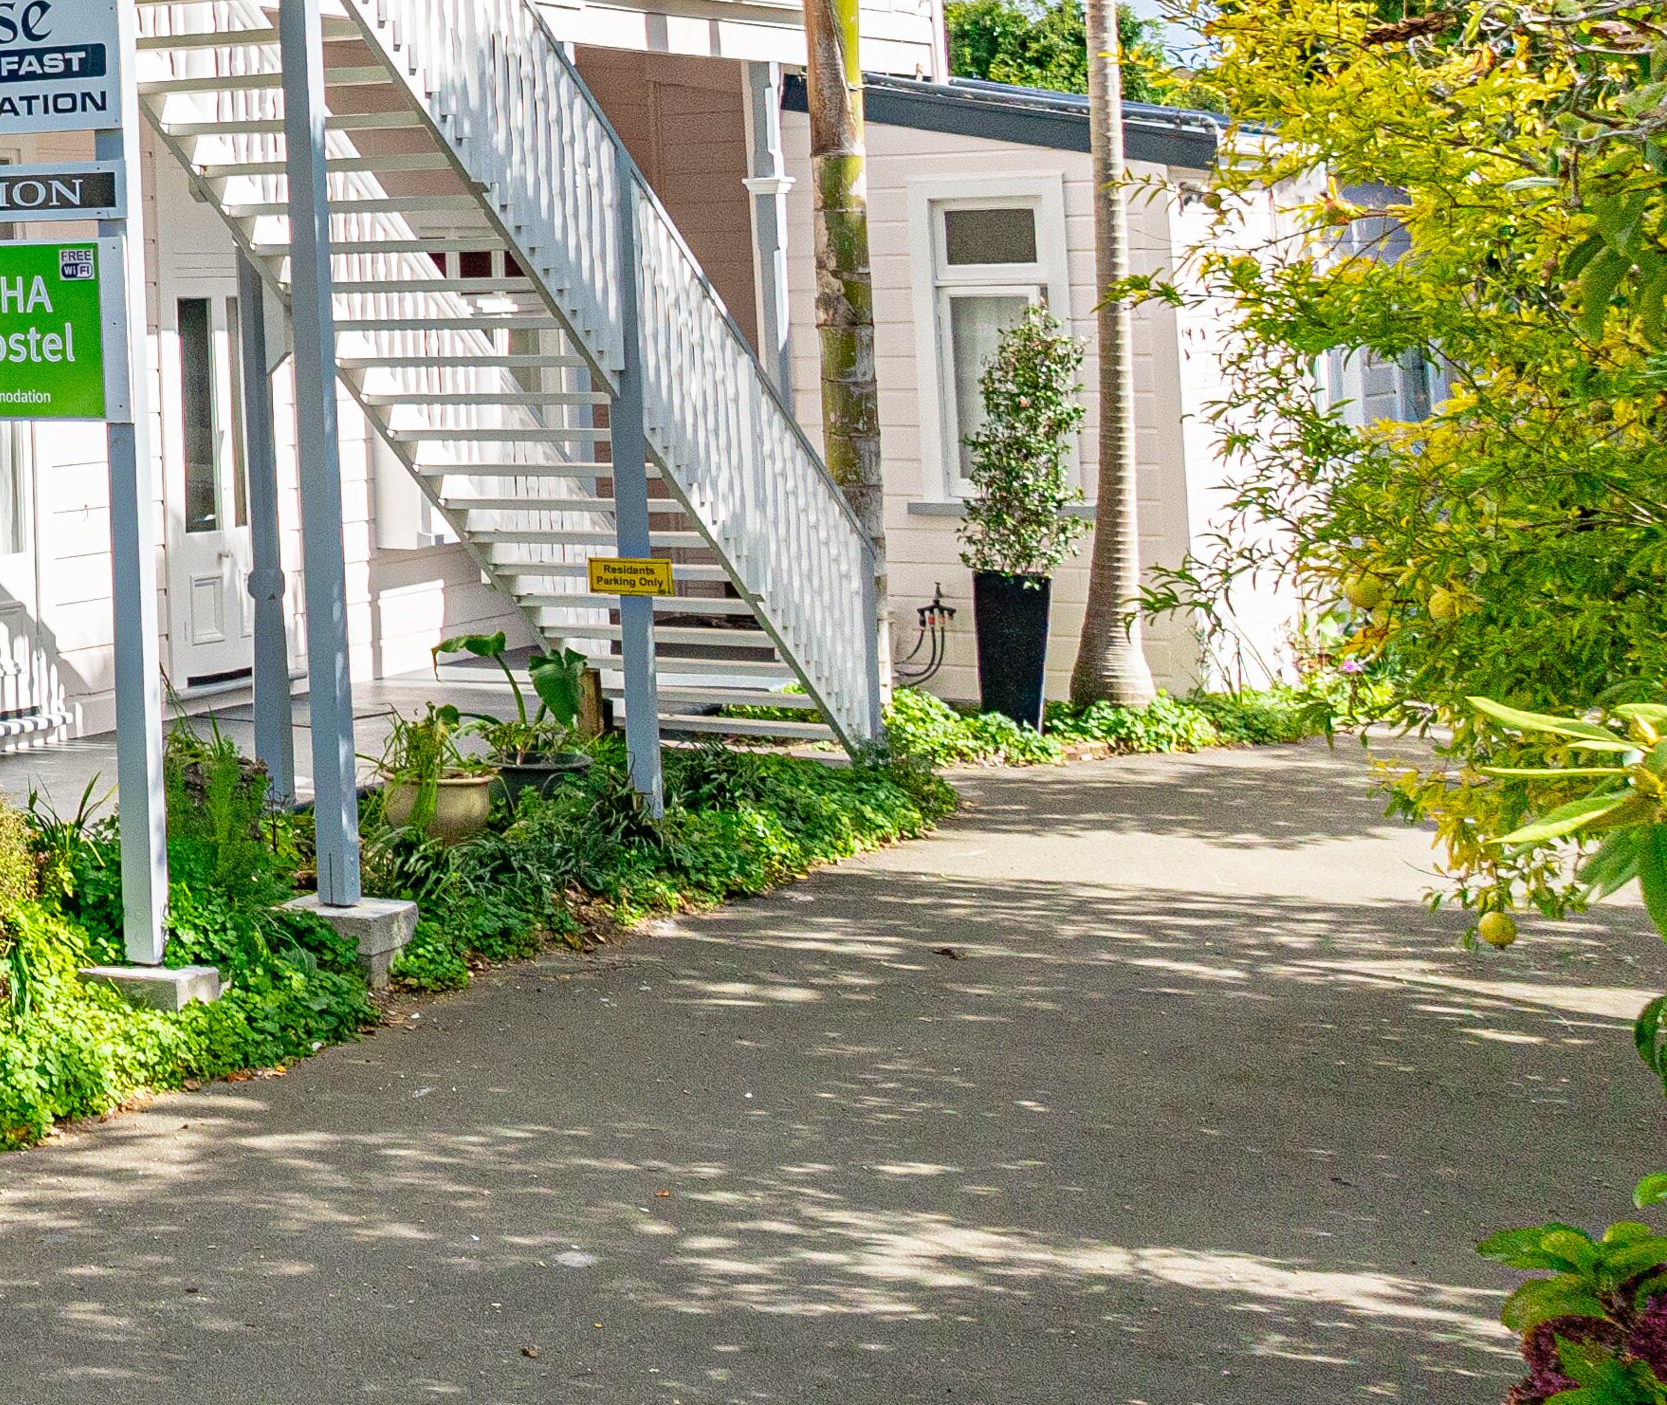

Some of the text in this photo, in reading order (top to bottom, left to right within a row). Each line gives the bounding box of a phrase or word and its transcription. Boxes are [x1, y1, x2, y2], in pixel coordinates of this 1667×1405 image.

[60, 250, 92, 261] FREE
[603, 564, 655, 575] Residents
[596, 576, 664, 588] Parking Only
